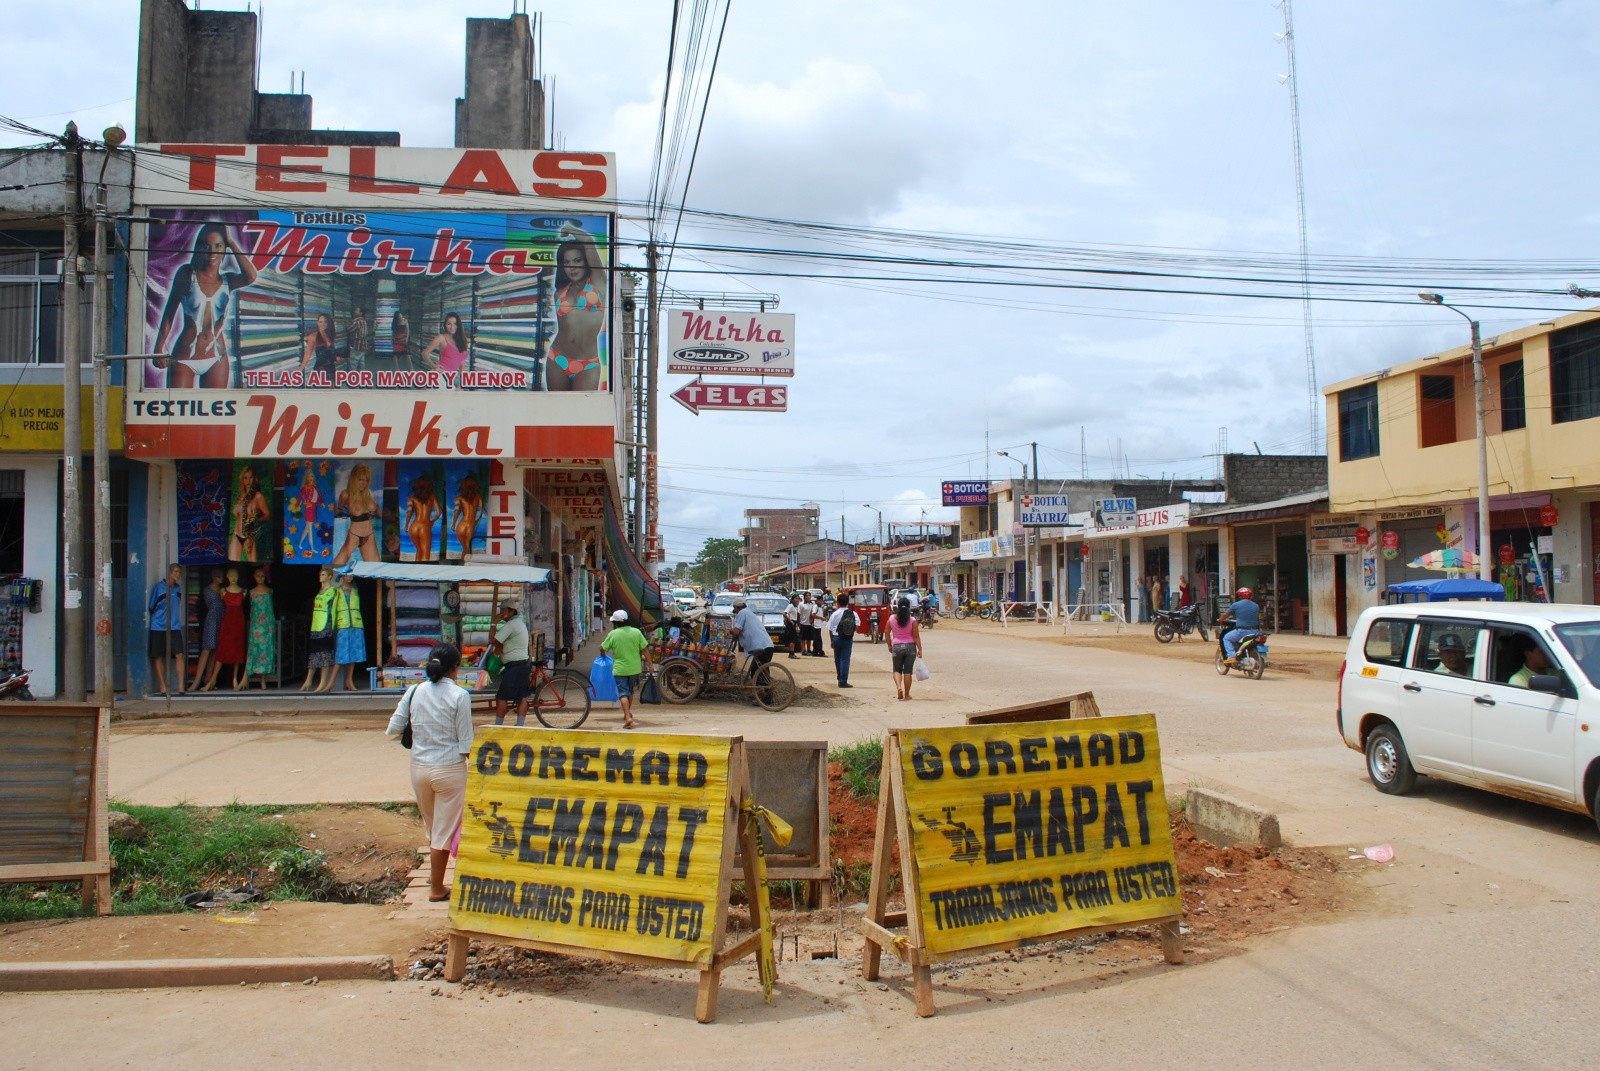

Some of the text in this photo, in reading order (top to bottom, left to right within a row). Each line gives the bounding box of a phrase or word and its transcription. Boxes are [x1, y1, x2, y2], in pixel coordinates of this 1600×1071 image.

[160, 144, 607, 197] TELAS
[294, 211, 366, 225] Textiles
[544, 219, 564, 227] BLU
[243, 220, 542, 275] Mirka
[682, 311, 785, 343] Mirka
[683, 350, 740, 361] Drimer
[246, 371, 526, 387] TELAS AL POR MAYOR Y MENOR
[685, 386, 786, 406] TELAS
[10, 408, 17, 418] A
[19, 408, 34, 418] LOS
[133, 400, 237, 417] TEXTILES
[23, 421, 59, 431] PRECIOS
[246, 394, 504, 456] Mirka
[541, 472, 607, 483] TELAS
[953, 483, 987, 494] BOTICA
[562, 498, 602, 506] TELA
[1034, 496, 1067, 506] BOTICA
[1103, 499, 1135, 511] ELVIS
[1022, 513, 1068, 523] BEATRIZ
[1137, 510, 1169, 528] ELVIS
[912, 731, 1145, 780] GOREMAD
[476, 741, 708, 788] GOREMAD
[983, 780, 1153, 864] EMAPAT
[517, 797, 708, 879] EMAPAT
[929, 860, 1177, 931] TRABAJAMOS PARA USTED
[457, 874, 705, 942] TRABAJAMOS PARA USTED
